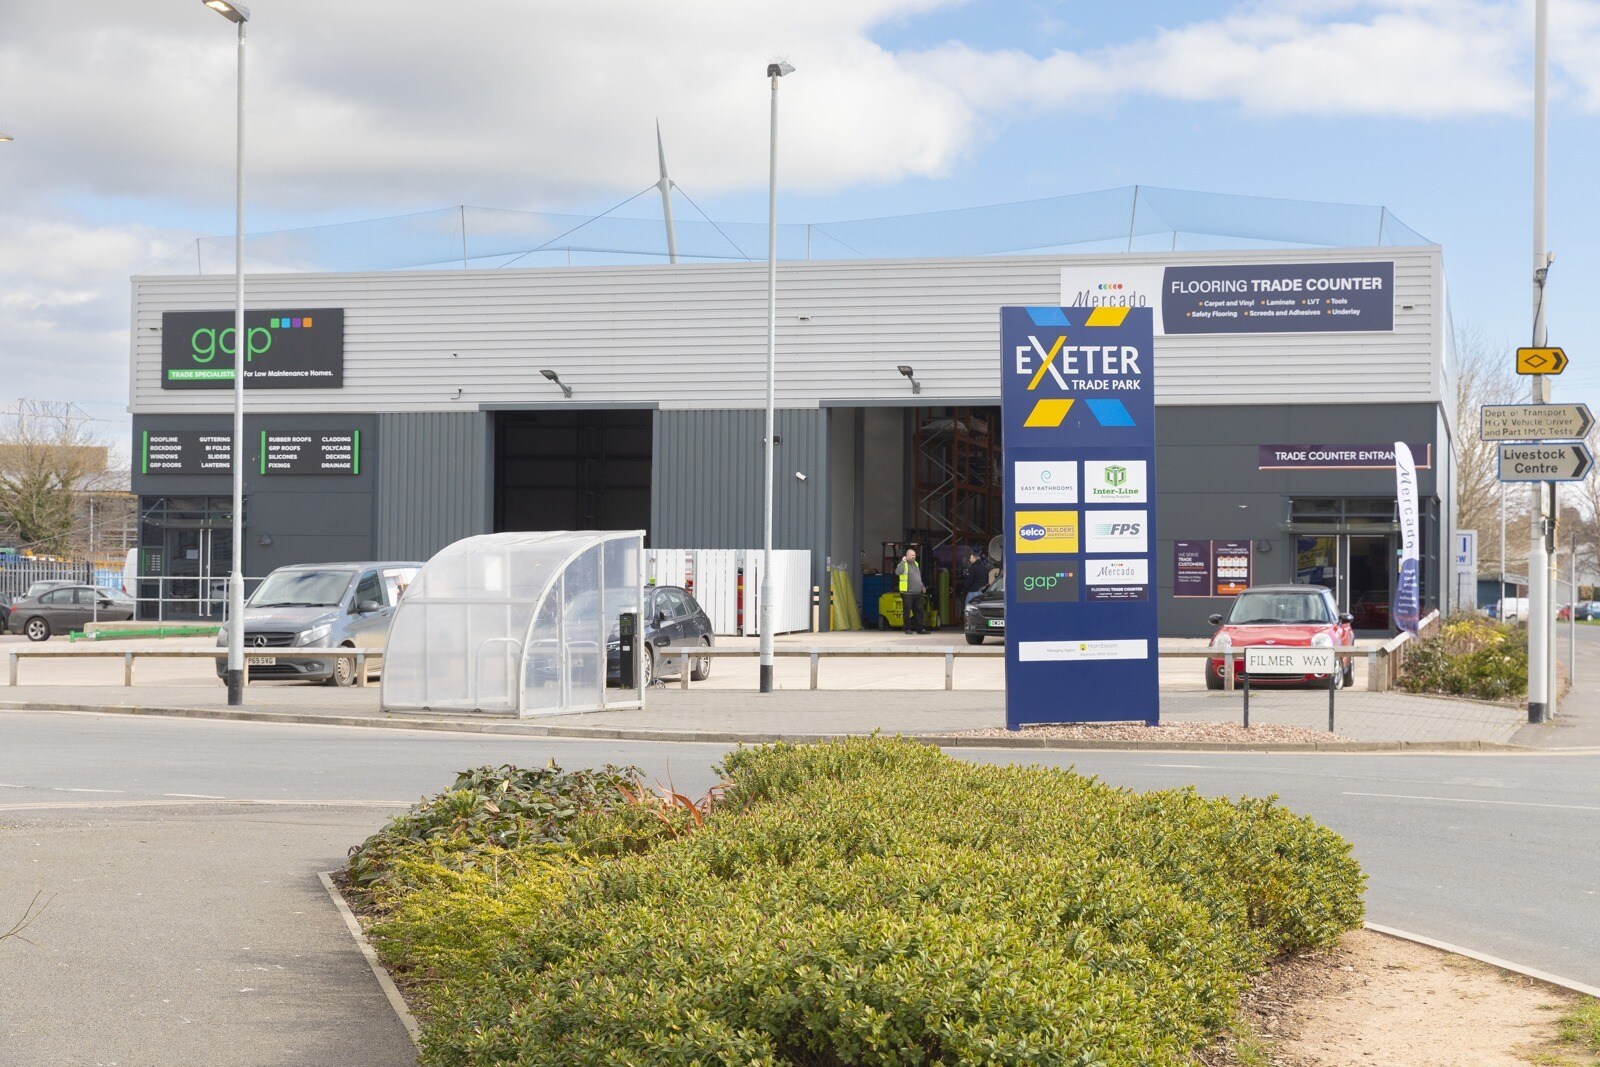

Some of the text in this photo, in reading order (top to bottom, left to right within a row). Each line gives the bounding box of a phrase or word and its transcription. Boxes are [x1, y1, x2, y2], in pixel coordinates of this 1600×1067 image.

[1171, 277, 1382, 294] FLOORING TRADE COUNTER
[1071, 290, 1146, 307] Mercado
[1204, 300, 1225, 308] Carpet
[1238, 299, 1255, 307] Vinyl
[1191, 310, 1238, 319] Safety Flooring
[1016, 336, 1141, 390] EXETER
[1071, 379, 1141, 390] TRADE PARK
[1485, 409, 1505, 418] Dept
[1523, 409, 1567, 418] Transport
[1511, 418, 1543, 426] Vehicle
[1546, 418, 1573, 426] Driver
[1502, 428, 1521, 436] Part
[1275, 450, 1397, 461] TRADE COUNTER ENTRAN
[1504, 449, 1566, 460] Livestock
[1514, 462, 1558, 474] Centre
[1398, 460, 1415, 549] Mercado
[1020, 527, 1045, 537] selco
[1110, 523, 1140, 535] FPS
[1097, 566, 1135, 577] Mercado
[1023, 576, 1057, 591] gap
[1250, 655, 1329, 666] FILMER WAY
